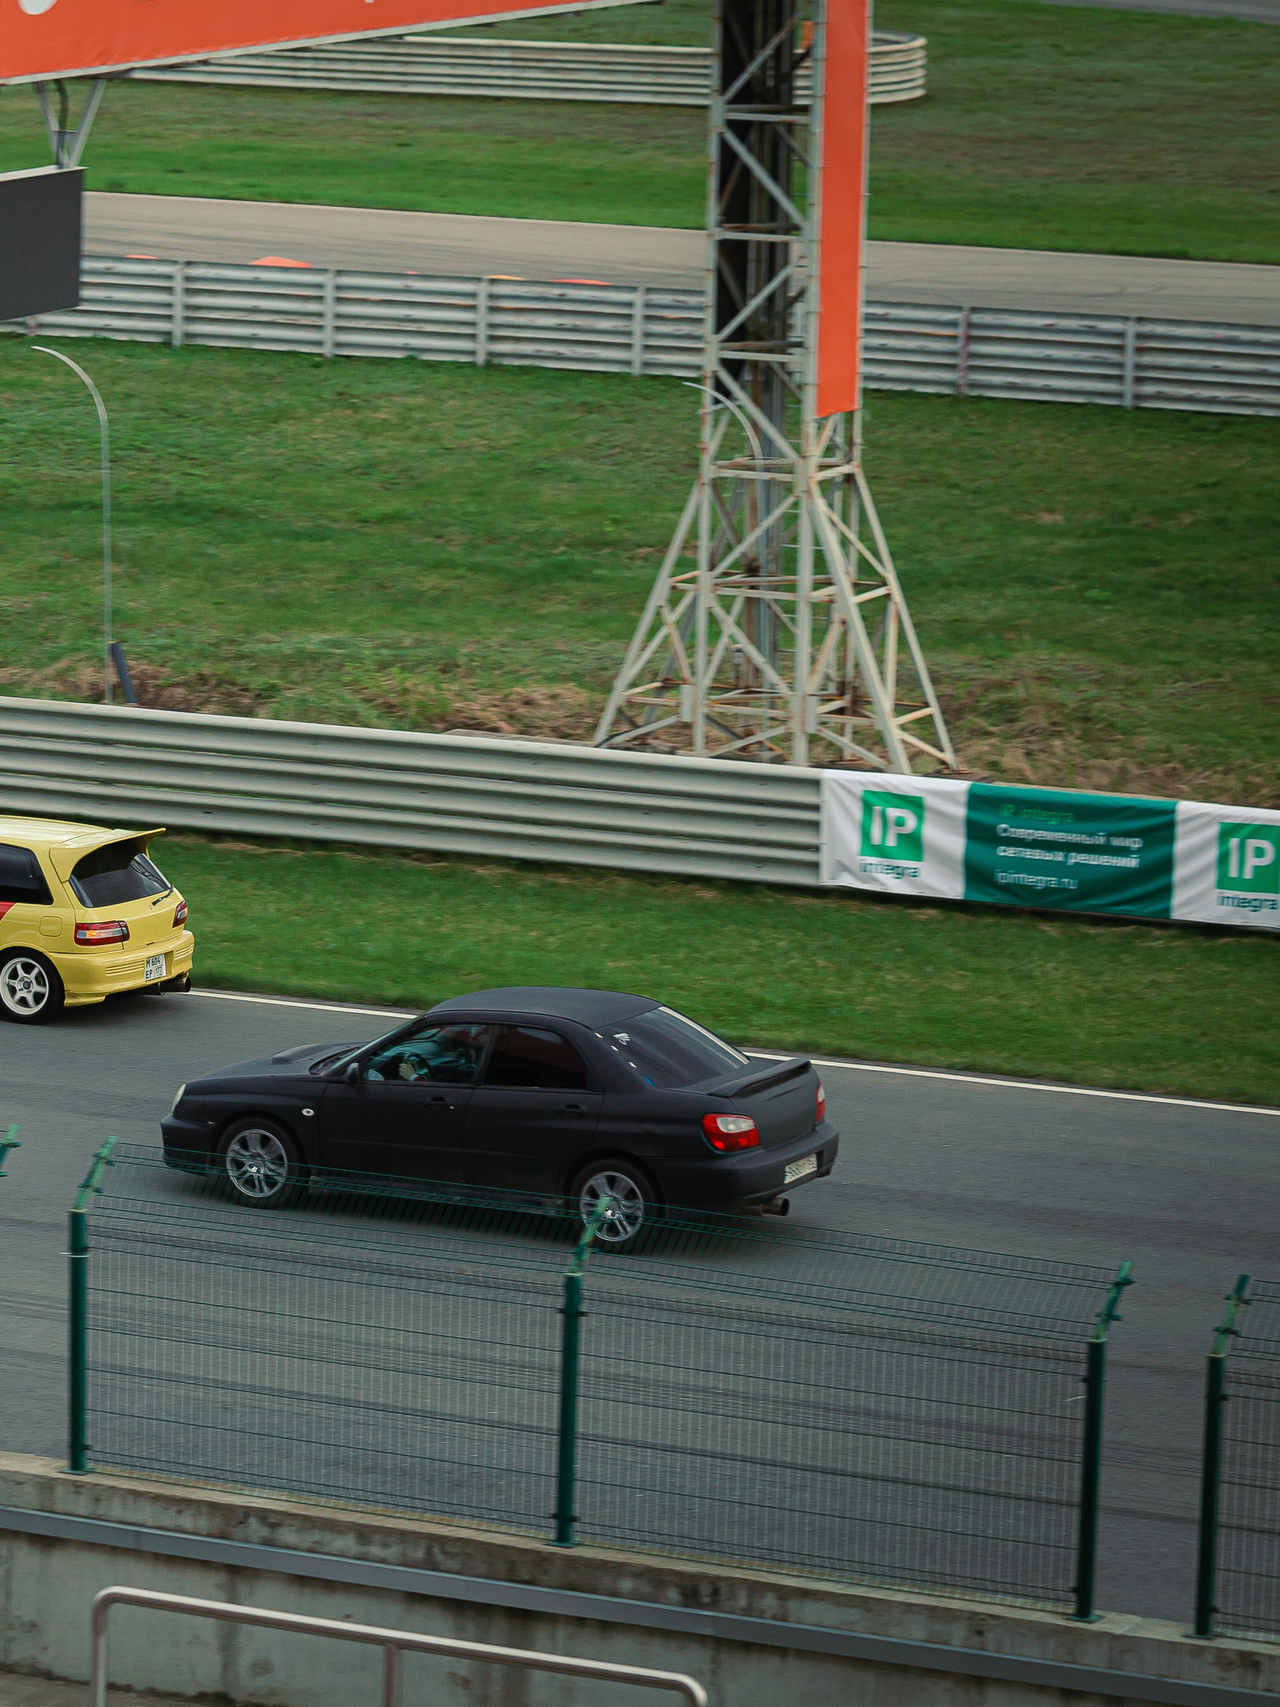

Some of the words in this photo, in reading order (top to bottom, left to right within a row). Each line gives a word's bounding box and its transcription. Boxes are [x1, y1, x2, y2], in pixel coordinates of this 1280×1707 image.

[870, 806, 918, 847] IP
[860, 859, 920, 880] integra
[1228, 838, 1276, 879] IP
[1216, 892, 1278, 912] integra
